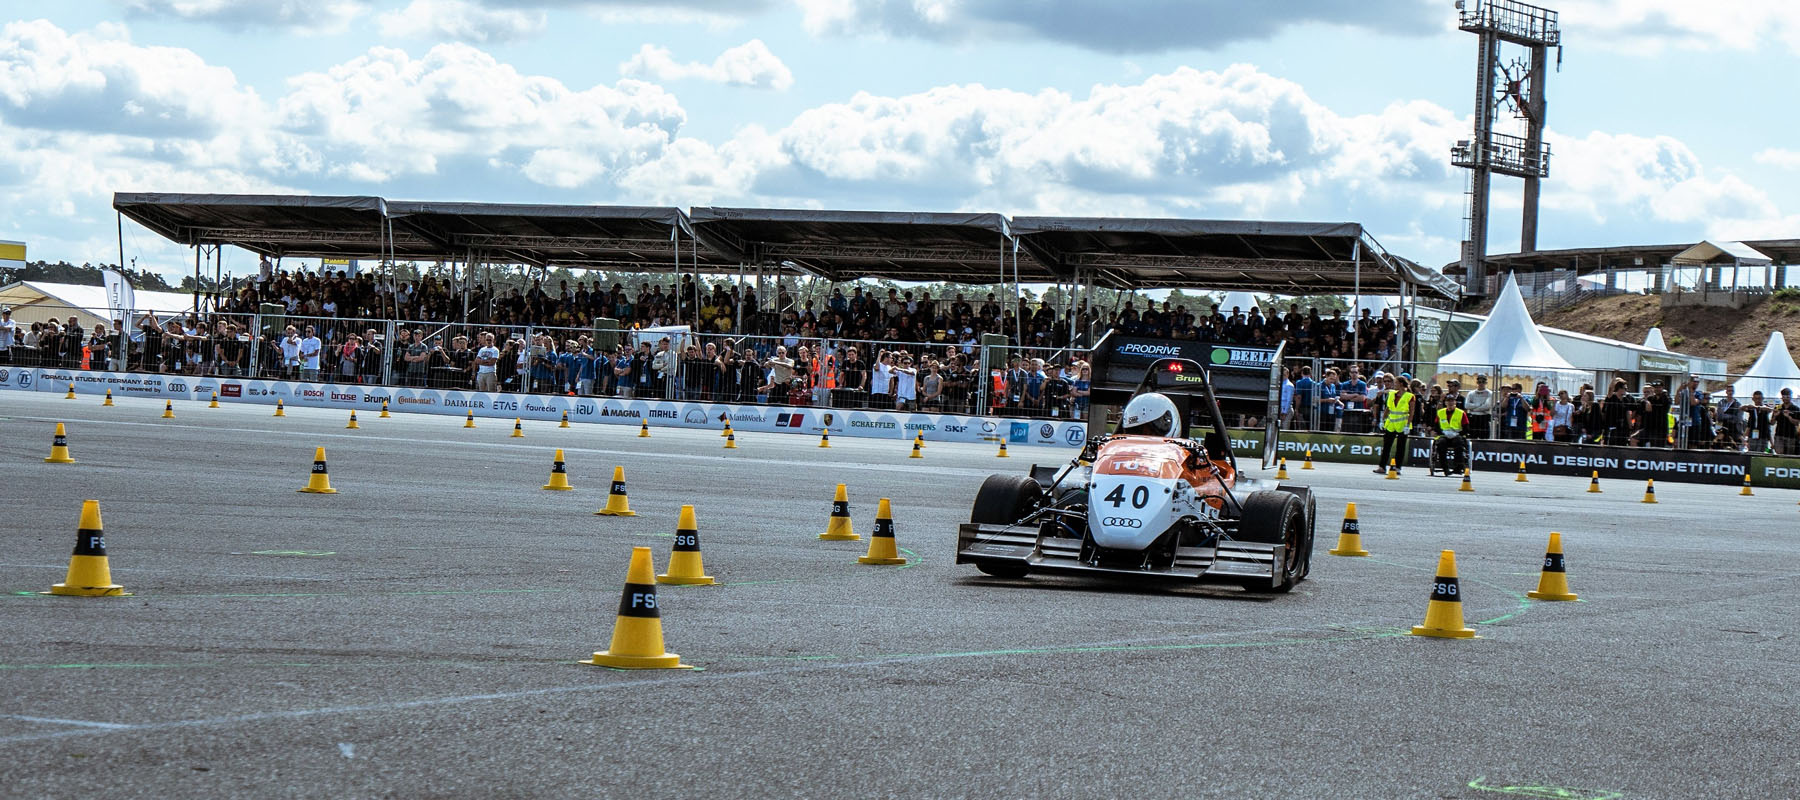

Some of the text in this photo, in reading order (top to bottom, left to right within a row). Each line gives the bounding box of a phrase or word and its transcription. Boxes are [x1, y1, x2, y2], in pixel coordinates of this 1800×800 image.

[1125, 343, 1181, 355] PRODRIVE
[1229, 360, 1272, 368] ENGINEERIN
[41, 374, 73, 382] FORMULA
[1176, 374, 1202, 382] Brun
[303, 389, 324, 397] BOSCH
[331, 391, 357, 401] brose
[364, 393, 391, 404] Brunel
[398, 395, 432, 405] Continental
[444, 399, 485, 409] DAIMLER
[492, 401, 518, 411] ETAS
[525, 403, 557, 413] faurecia
[610, 409, 641, 418] MAGNA
[649, 409, 678, 419] MAHLE
[729, 413, 767, 423] MathWorks
[851, 420, 896, 429] SCHAEFFLER
[904, 423, 936, 431] SIEMENS
[944, 424, 968, 433] SKF
[1012, 428, 1026, 437] VDI
[1277, 441, 1345, 454] ERMANY
[1351, 444, 1384, 456] 201
[1553, 455, 1618, 469] DESIGN
[1624, 459, 1745, 475] COMPETITION
[1104, 483, 1150, 509] 40
[632, 592, 659, 609] FS
